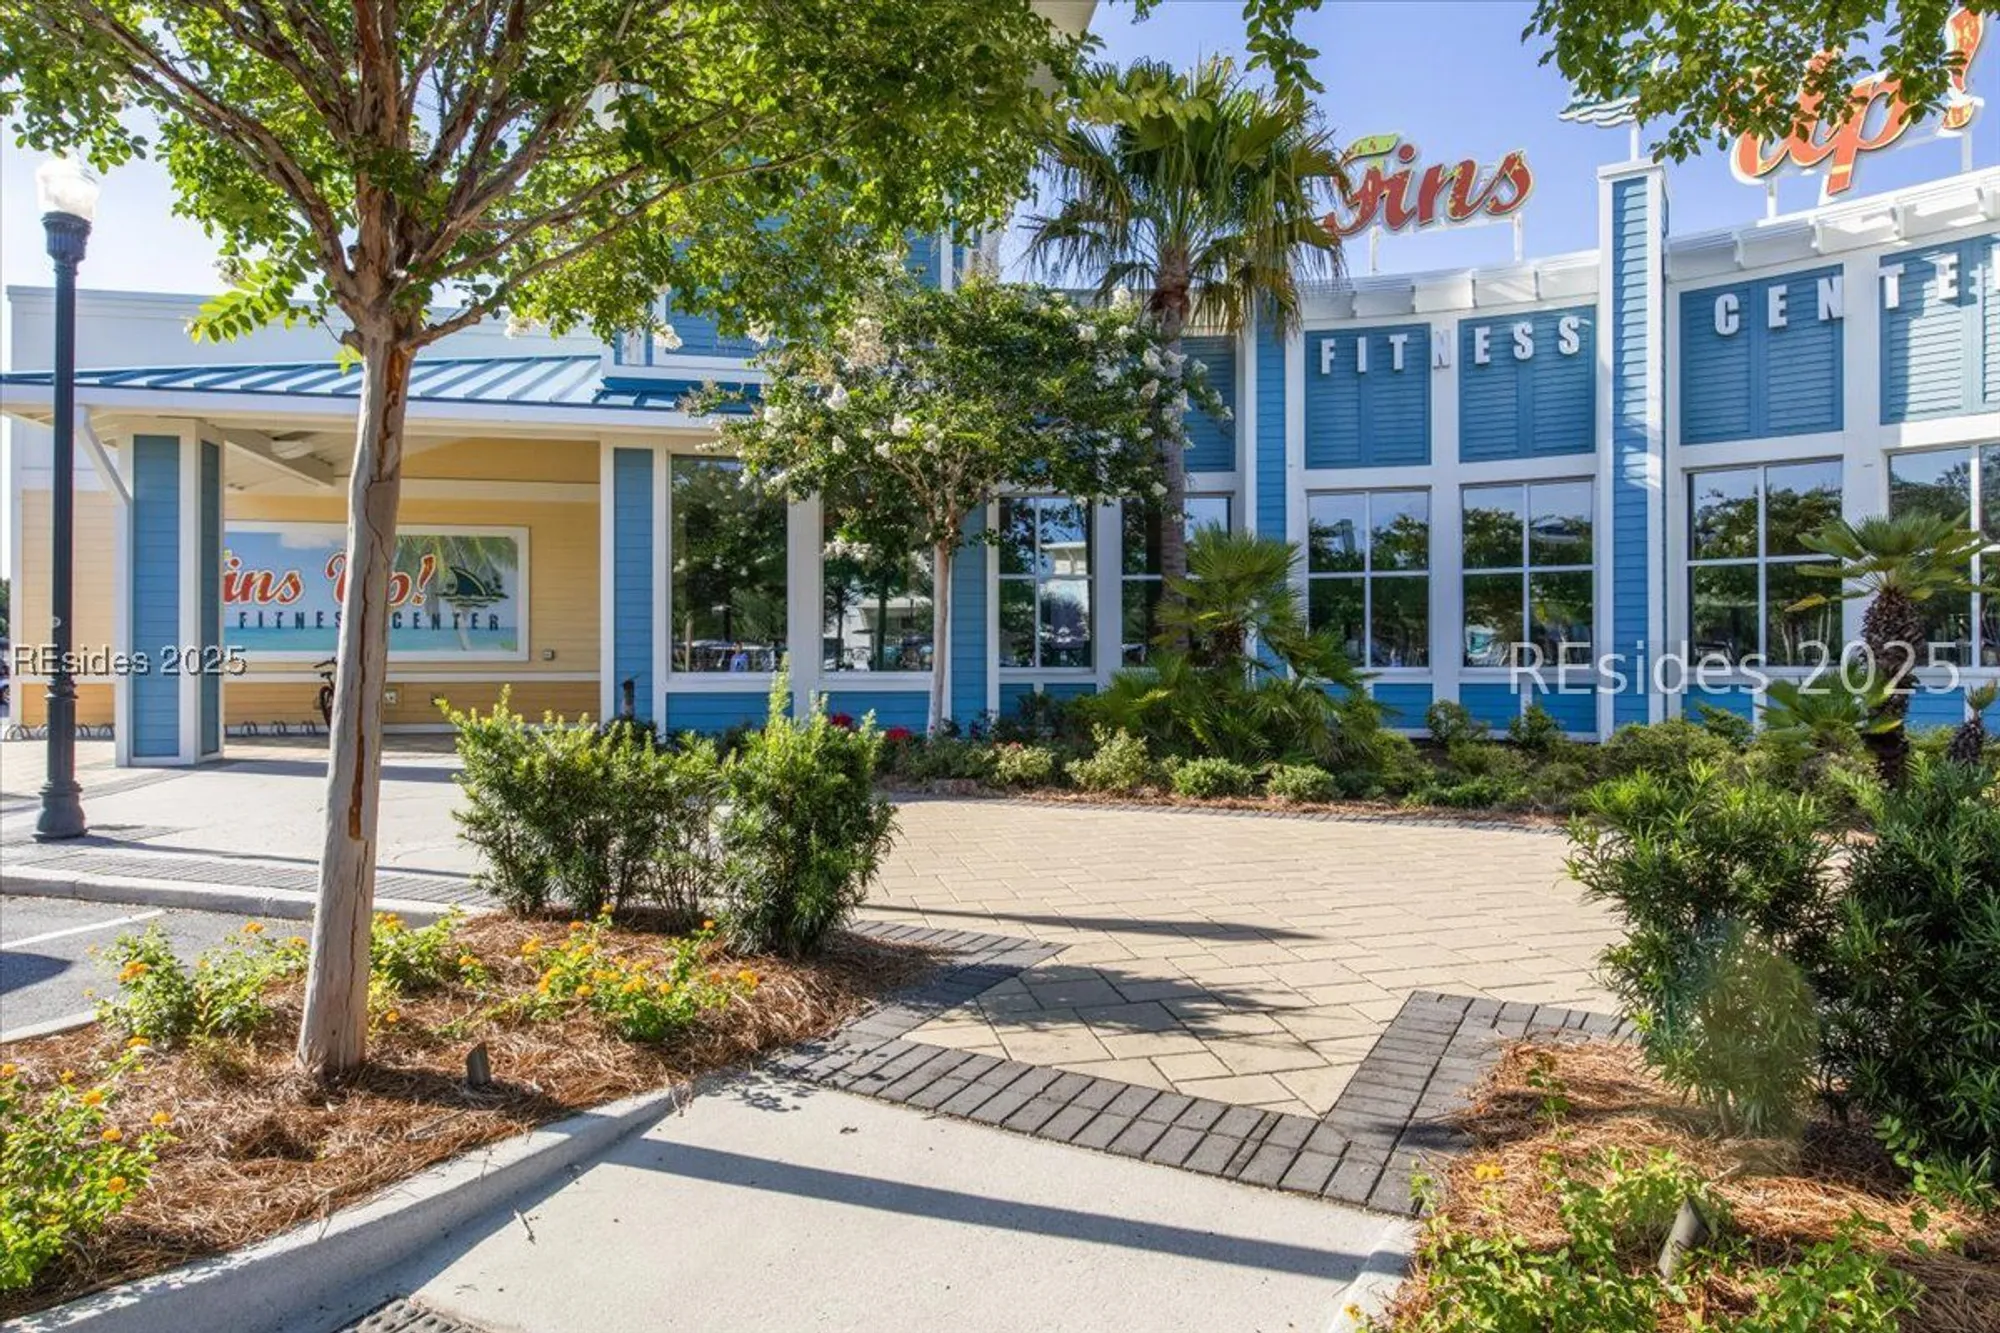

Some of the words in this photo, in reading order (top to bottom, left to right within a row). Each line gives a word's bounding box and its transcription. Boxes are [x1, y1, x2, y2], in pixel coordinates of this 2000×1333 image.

[1317, 133, 1534, 237] Fins
[1320, 315, 1581, 374] FITNESS
[1714, 244, 2000, 336] CENTE
[222, 551, 304, 605] ins
[239, 611, 342, 630] FITNES
[392, 611, 500, 631] CENTER
